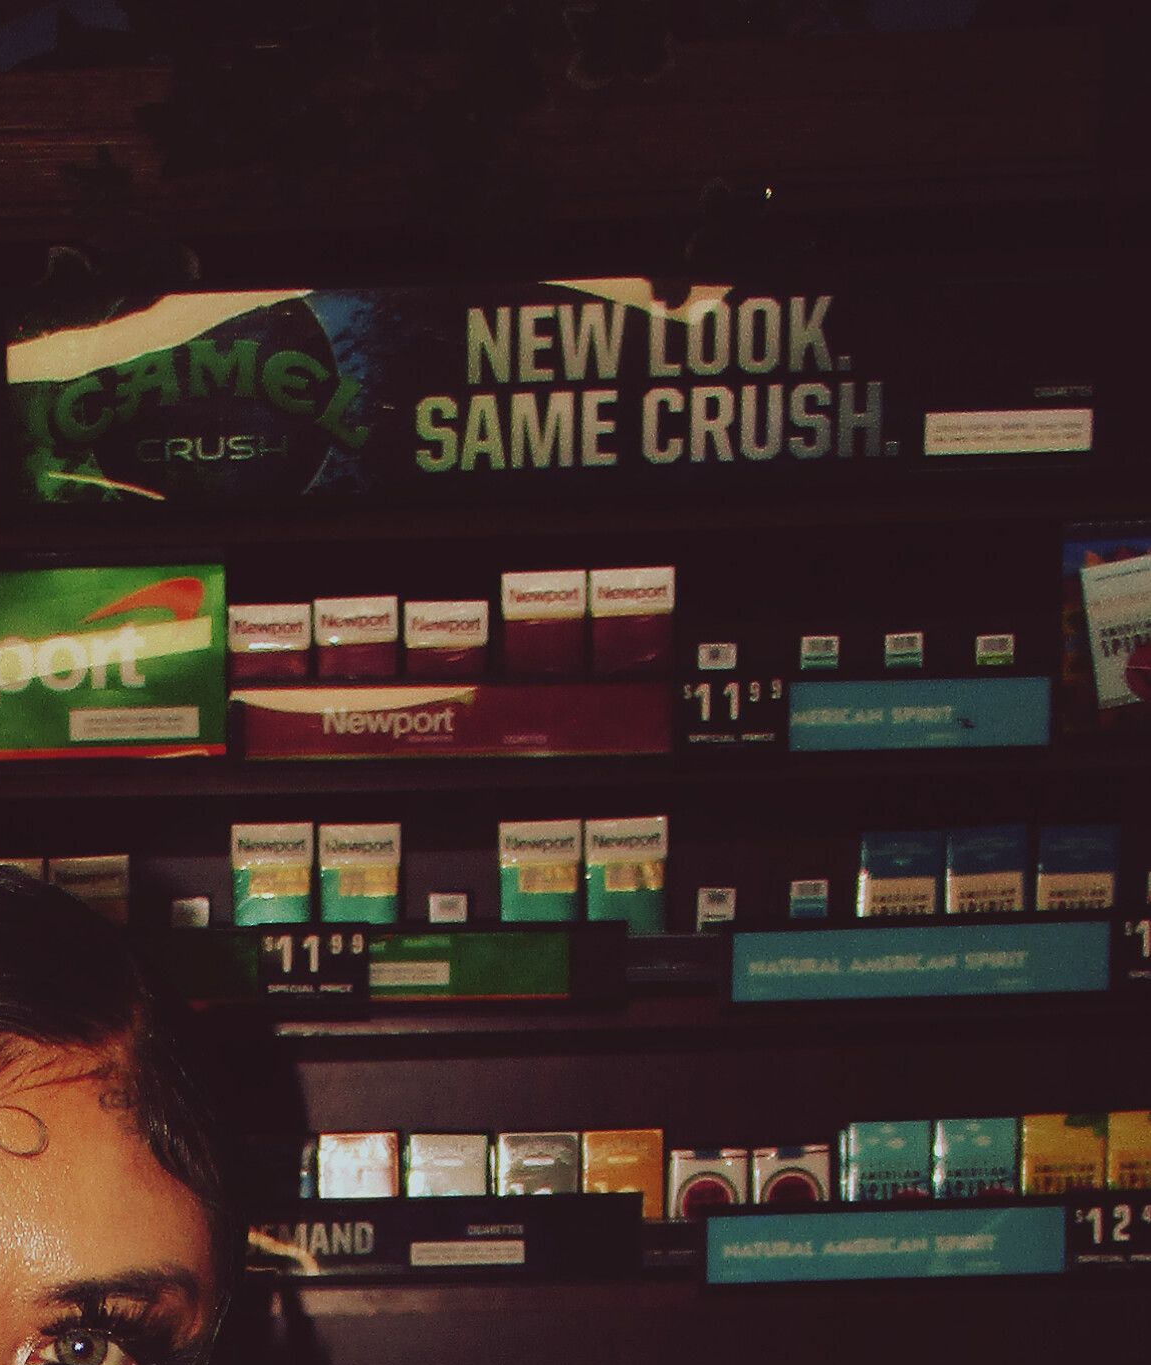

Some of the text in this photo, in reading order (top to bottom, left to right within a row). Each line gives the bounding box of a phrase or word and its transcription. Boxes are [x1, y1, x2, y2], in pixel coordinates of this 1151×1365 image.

[466, 296, 851, 384] NEW LOOK.
[53, 339, 370, 448] CAMEL
[416, 381, 901, 473] SAME CRUSH.
[137, 435, 289, 463] CRUSH
[509, 587, 579, 603] Newport
[597, 583, 668, 602] Newport
[234, 618, 304, 637] Newport
[320, 612, 390, 630] Newport
[412, 614, 481, 634] Newport
[322, 707, 455, 740] Newport
[238, 836, 306, 852] Newport
[592, 832, 661, 849] Newport
[822, 1236, 928, 1255] AMERICAN
